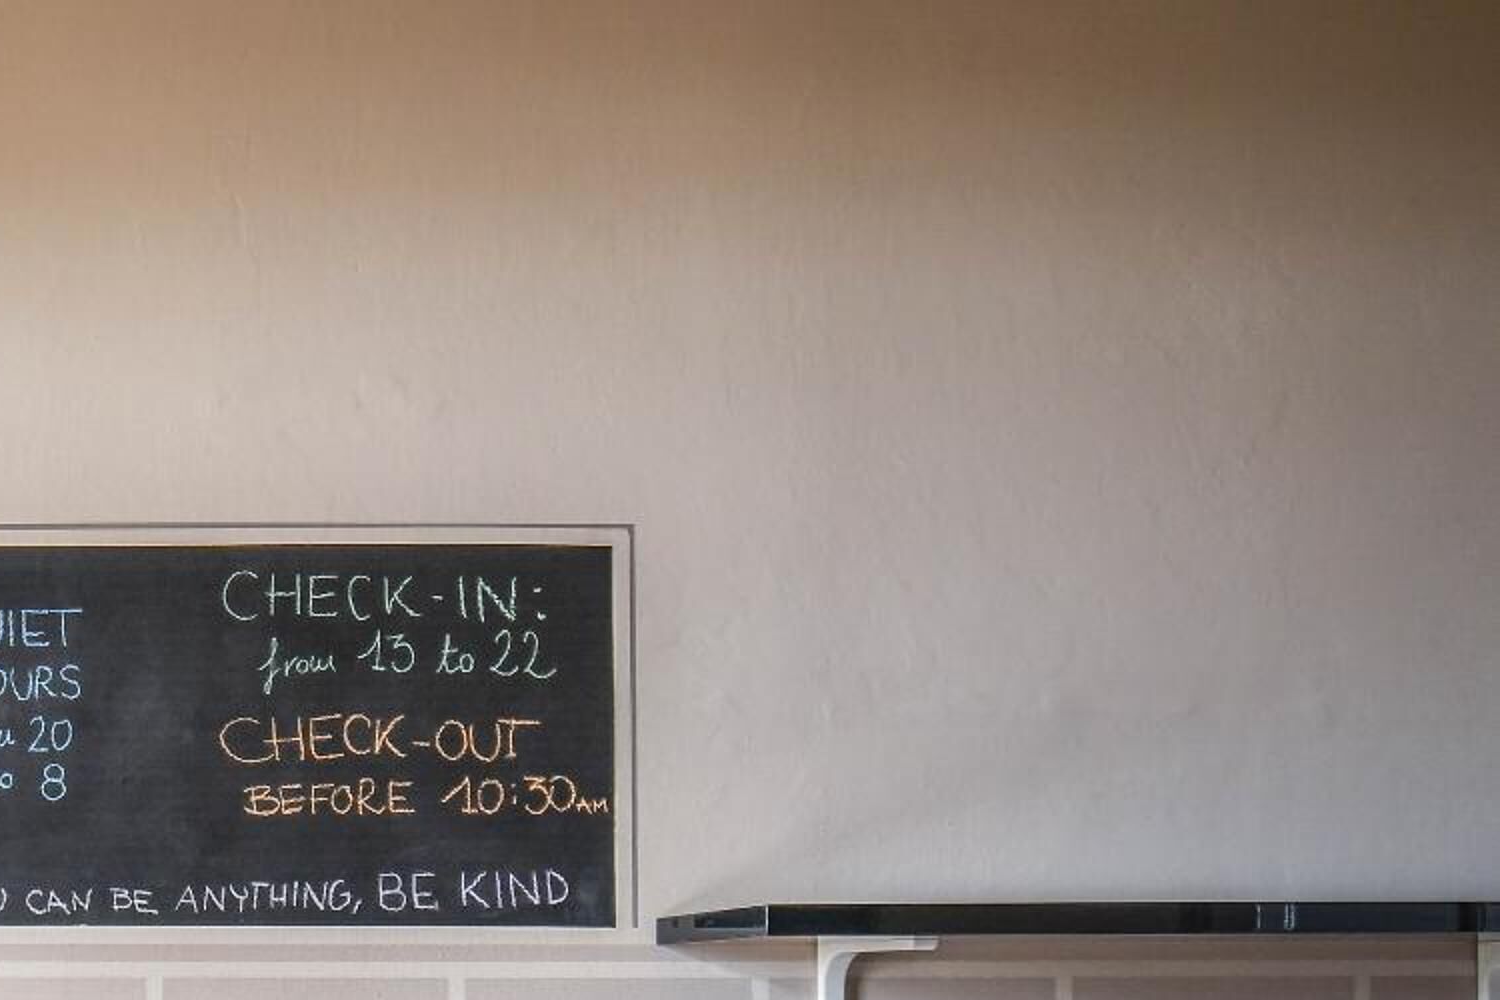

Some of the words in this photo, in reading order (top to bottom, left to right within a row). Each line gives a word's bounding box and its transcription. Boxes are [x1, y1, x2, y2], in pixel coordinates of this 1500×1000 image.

[222, 569, 547, 622] CHECK-IN:
[257, 637, 337, 695] from
[434, 633, 477, 675] to
[490, 629, 557, 680] 22
[27, 716, 73, 753] 20
[219, 713, 544, 764] CHECK-OUT
[42, 763, 67, 802] 8
[243, 777, 416, 816] BEFORE
[26, 888, 92, 915] CAN
[109, 888, 158, 915] BE
[175, 880, 362, 916] ANYTHING,
[377, 872, 439, 910] BE
[460, 870, 570, 910] KIND
